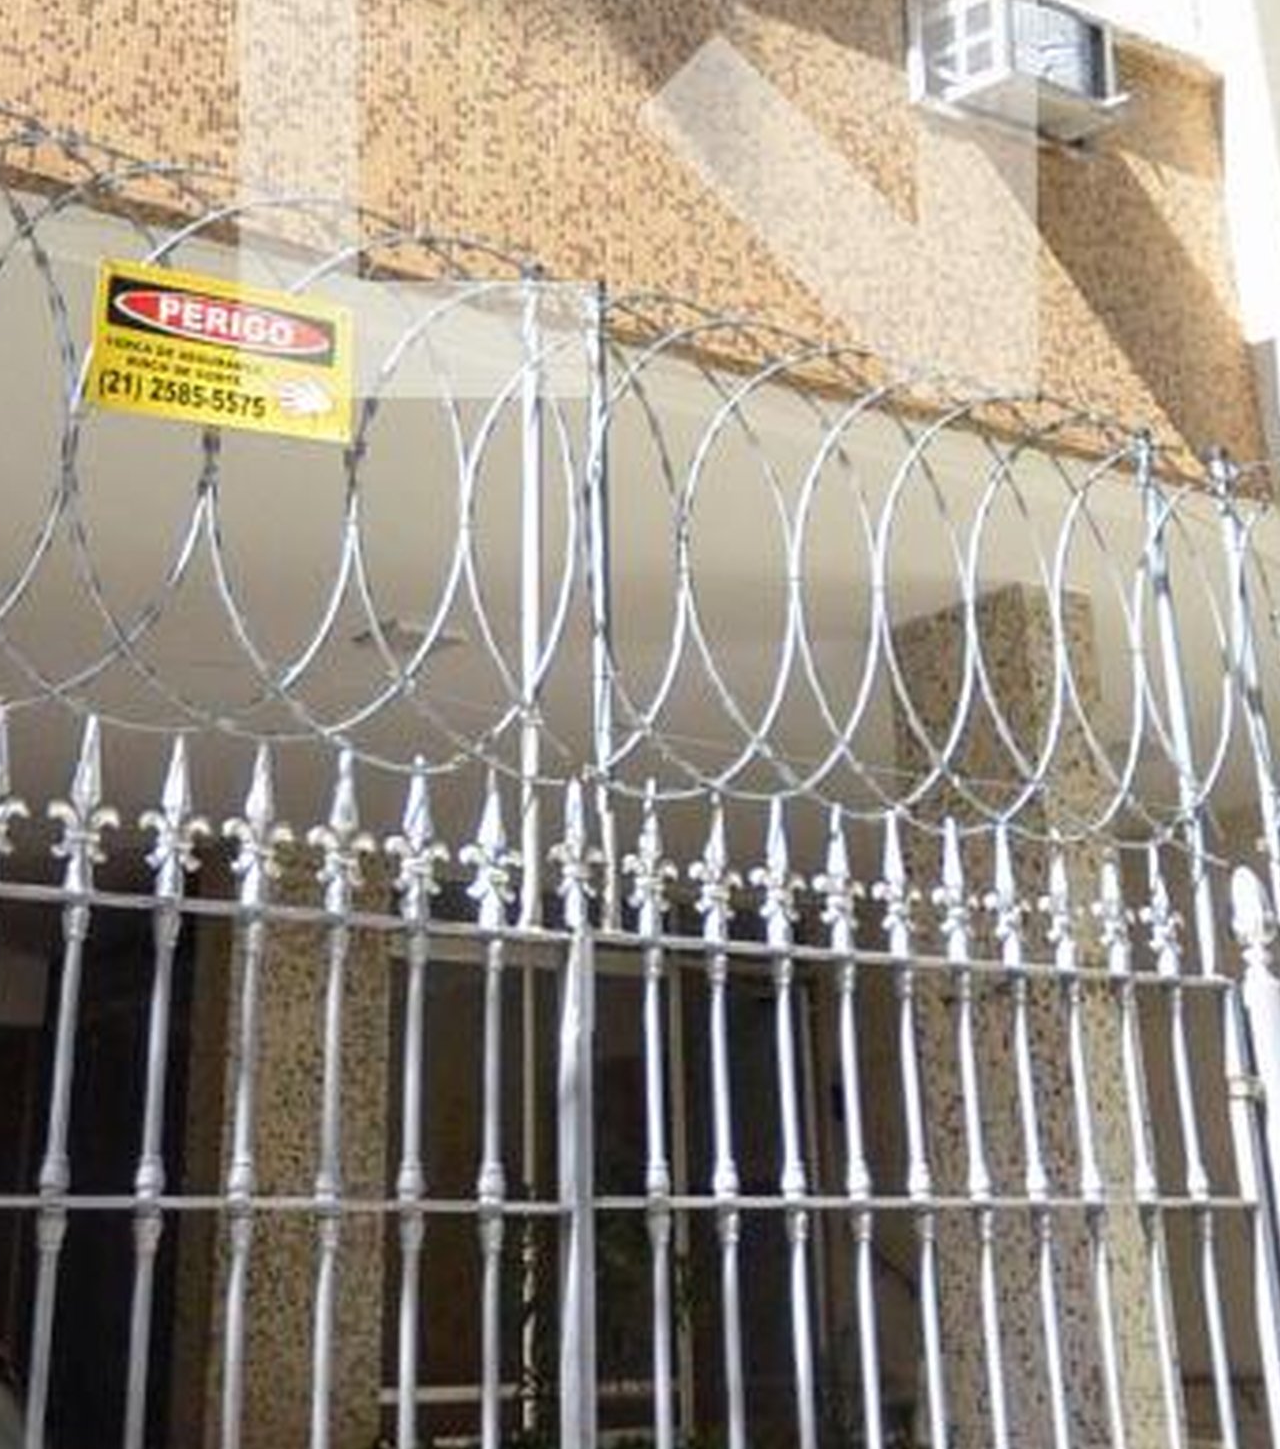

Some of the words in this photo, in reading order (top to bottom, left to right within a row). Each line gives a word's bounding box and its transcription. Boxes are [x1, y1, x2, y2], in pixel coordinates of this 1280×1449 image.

[158, 295, 295, 347] PERIGO
[99, 368, 142, 402] (21)
[150, 376, 267, 419] 2585-5575
